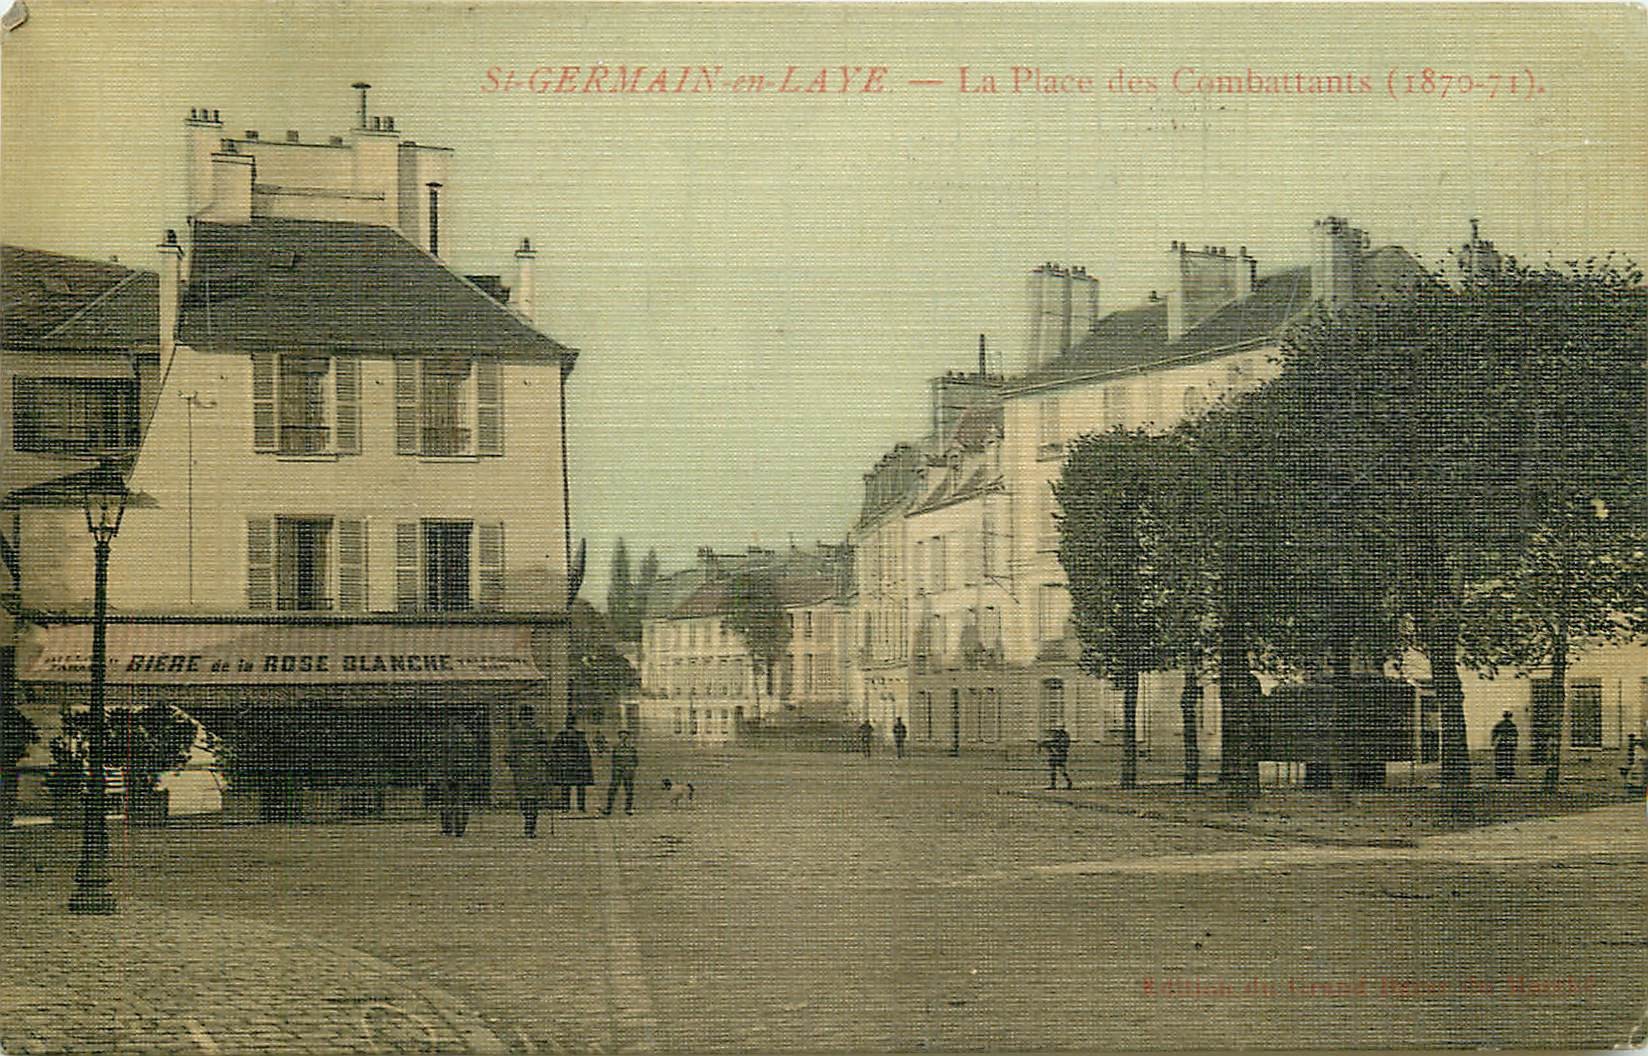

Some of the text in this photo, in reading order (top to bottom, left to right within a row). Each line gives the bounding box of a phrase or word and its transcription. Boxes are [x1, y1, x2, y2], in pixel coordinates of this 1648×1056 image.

[210, 658, 235, 673] de
[263, 654, 330, 673] ROSE
[342, 653, 455, 673] BLANCHE
